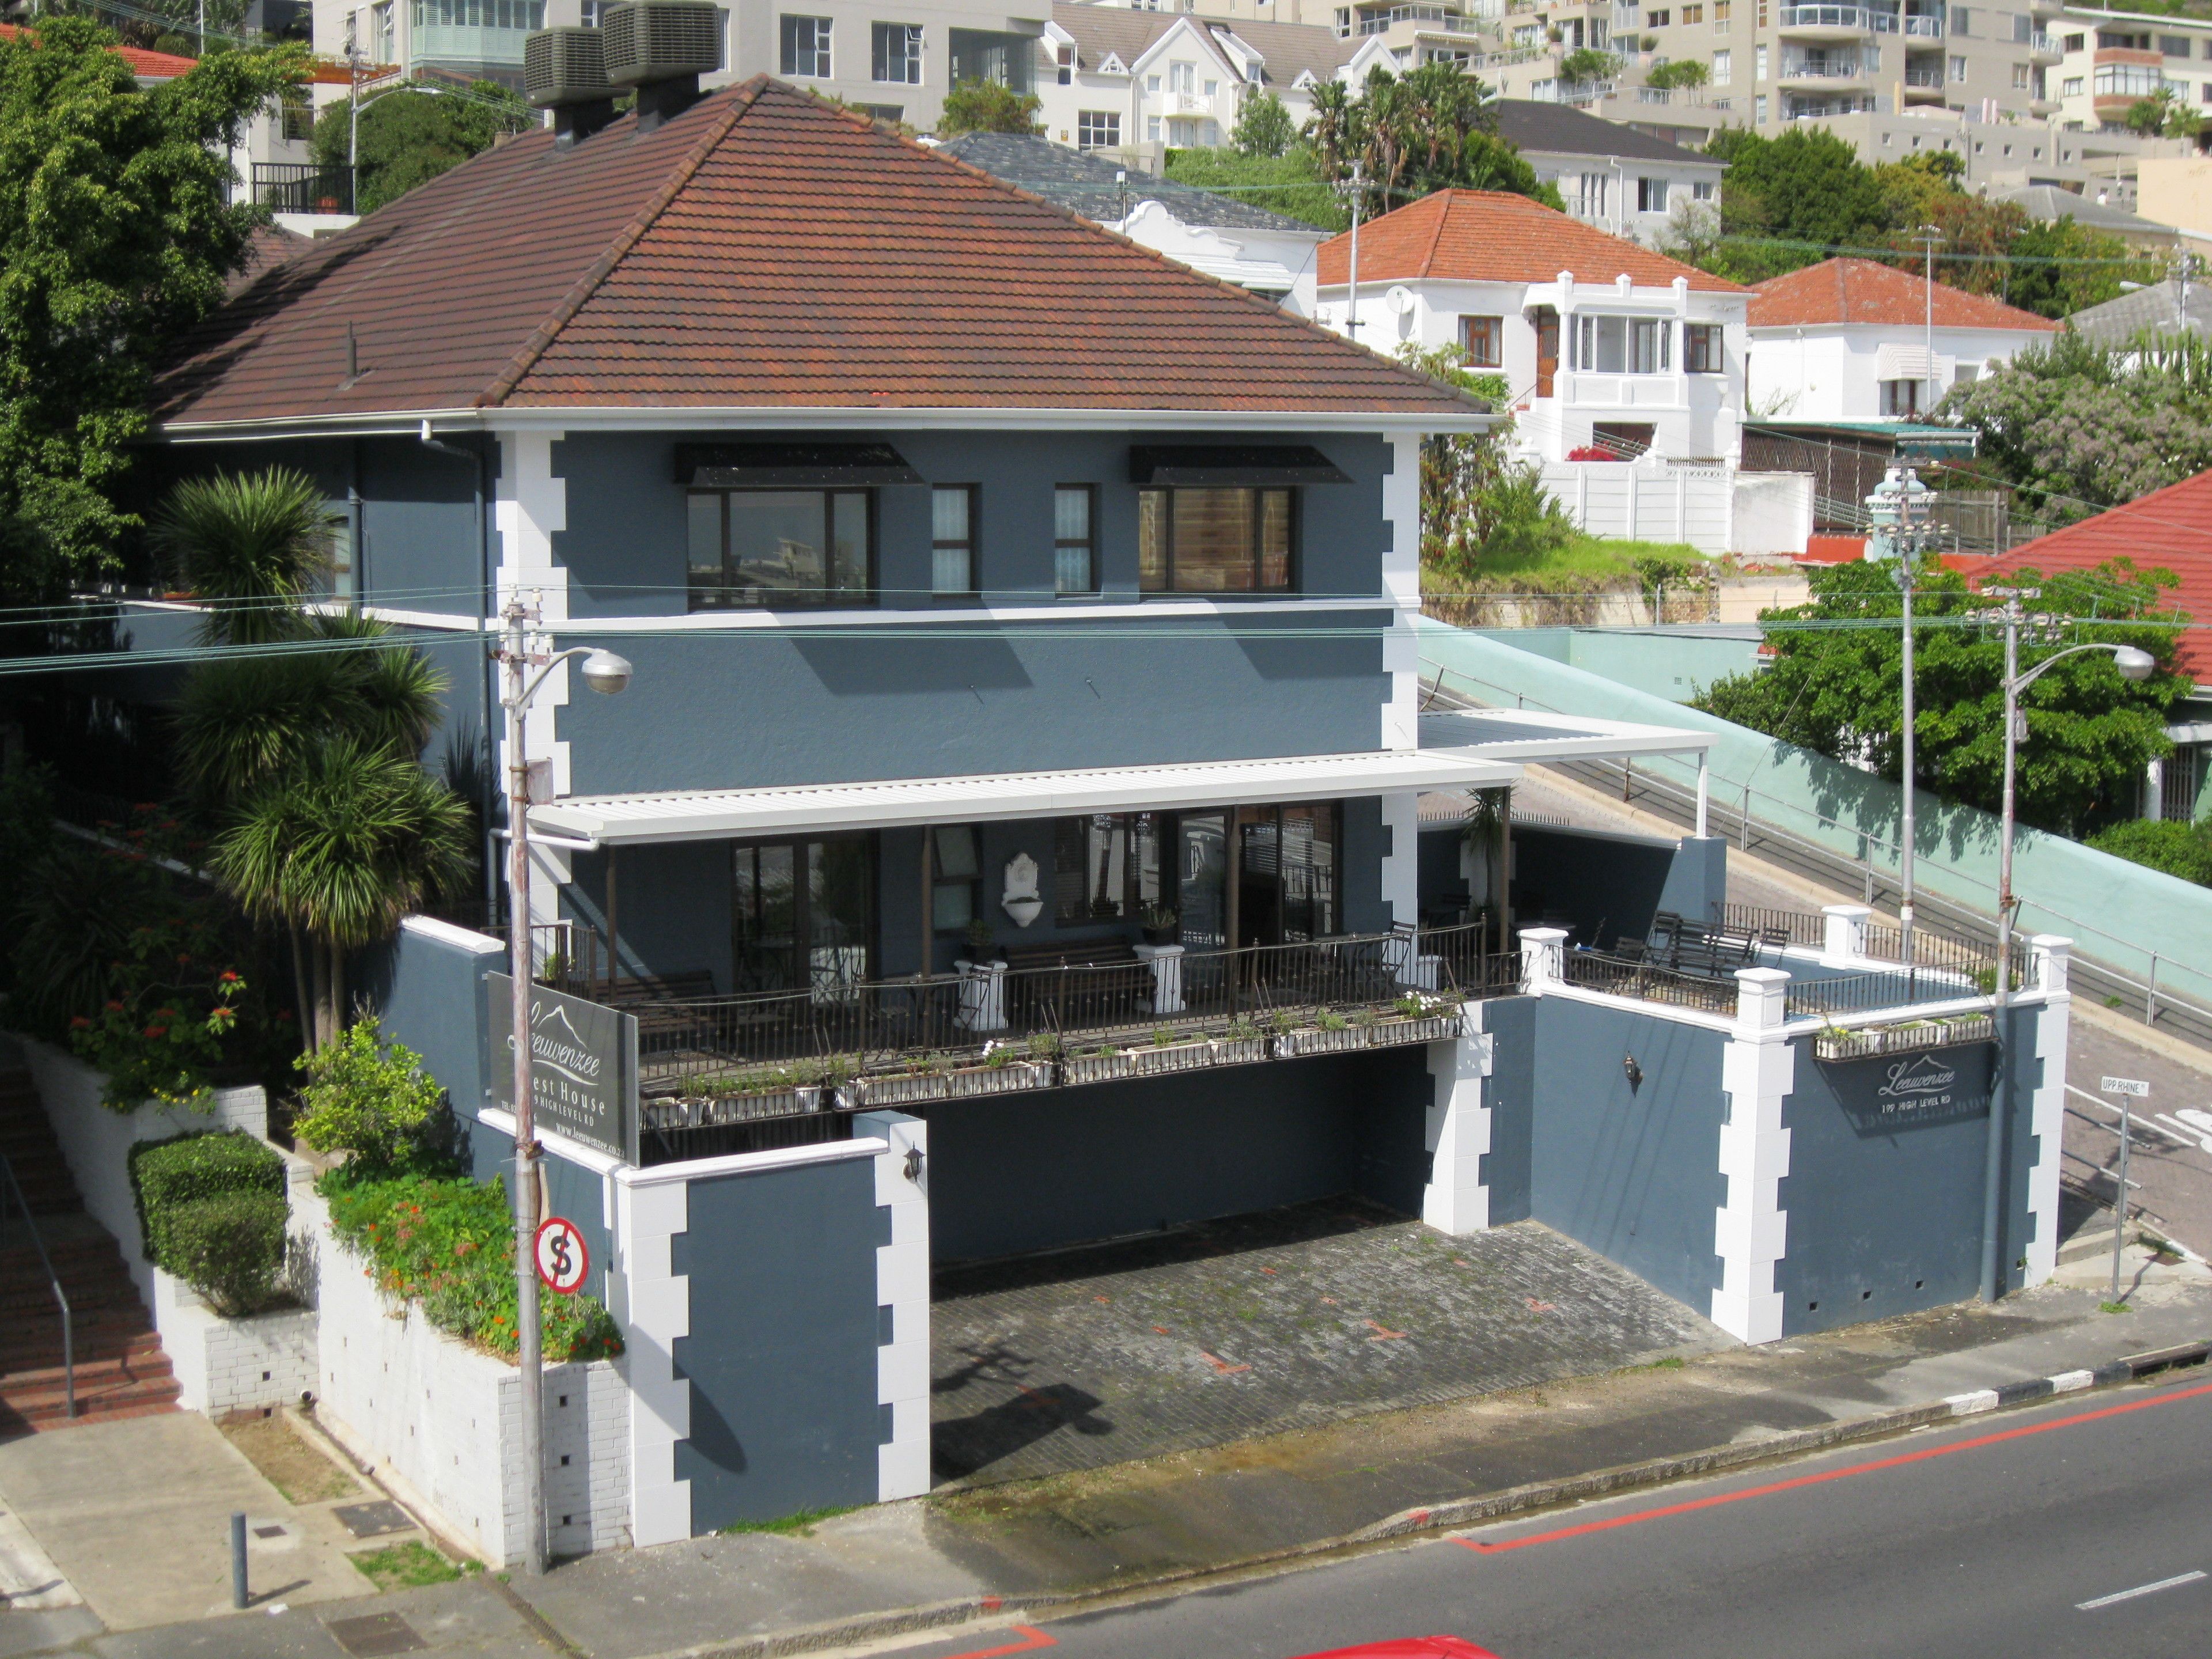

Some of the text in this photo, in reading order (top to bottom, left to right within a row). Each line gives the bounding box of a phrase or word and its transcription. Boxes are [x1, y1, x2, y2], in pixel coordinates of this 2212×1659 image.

[533, 1077, 605, 1116] est House
[540, 1096, 557, 1112] HIGH
[559, 1104, 582, 1122] LEVEL
[584, 1114, 594, 1127] RD
[1882, 1103, 1895, 1113] 199
[1898, 1100, 1917, 1111] HIGH
[1920, 1096, 1939, 1107] LEVEL
